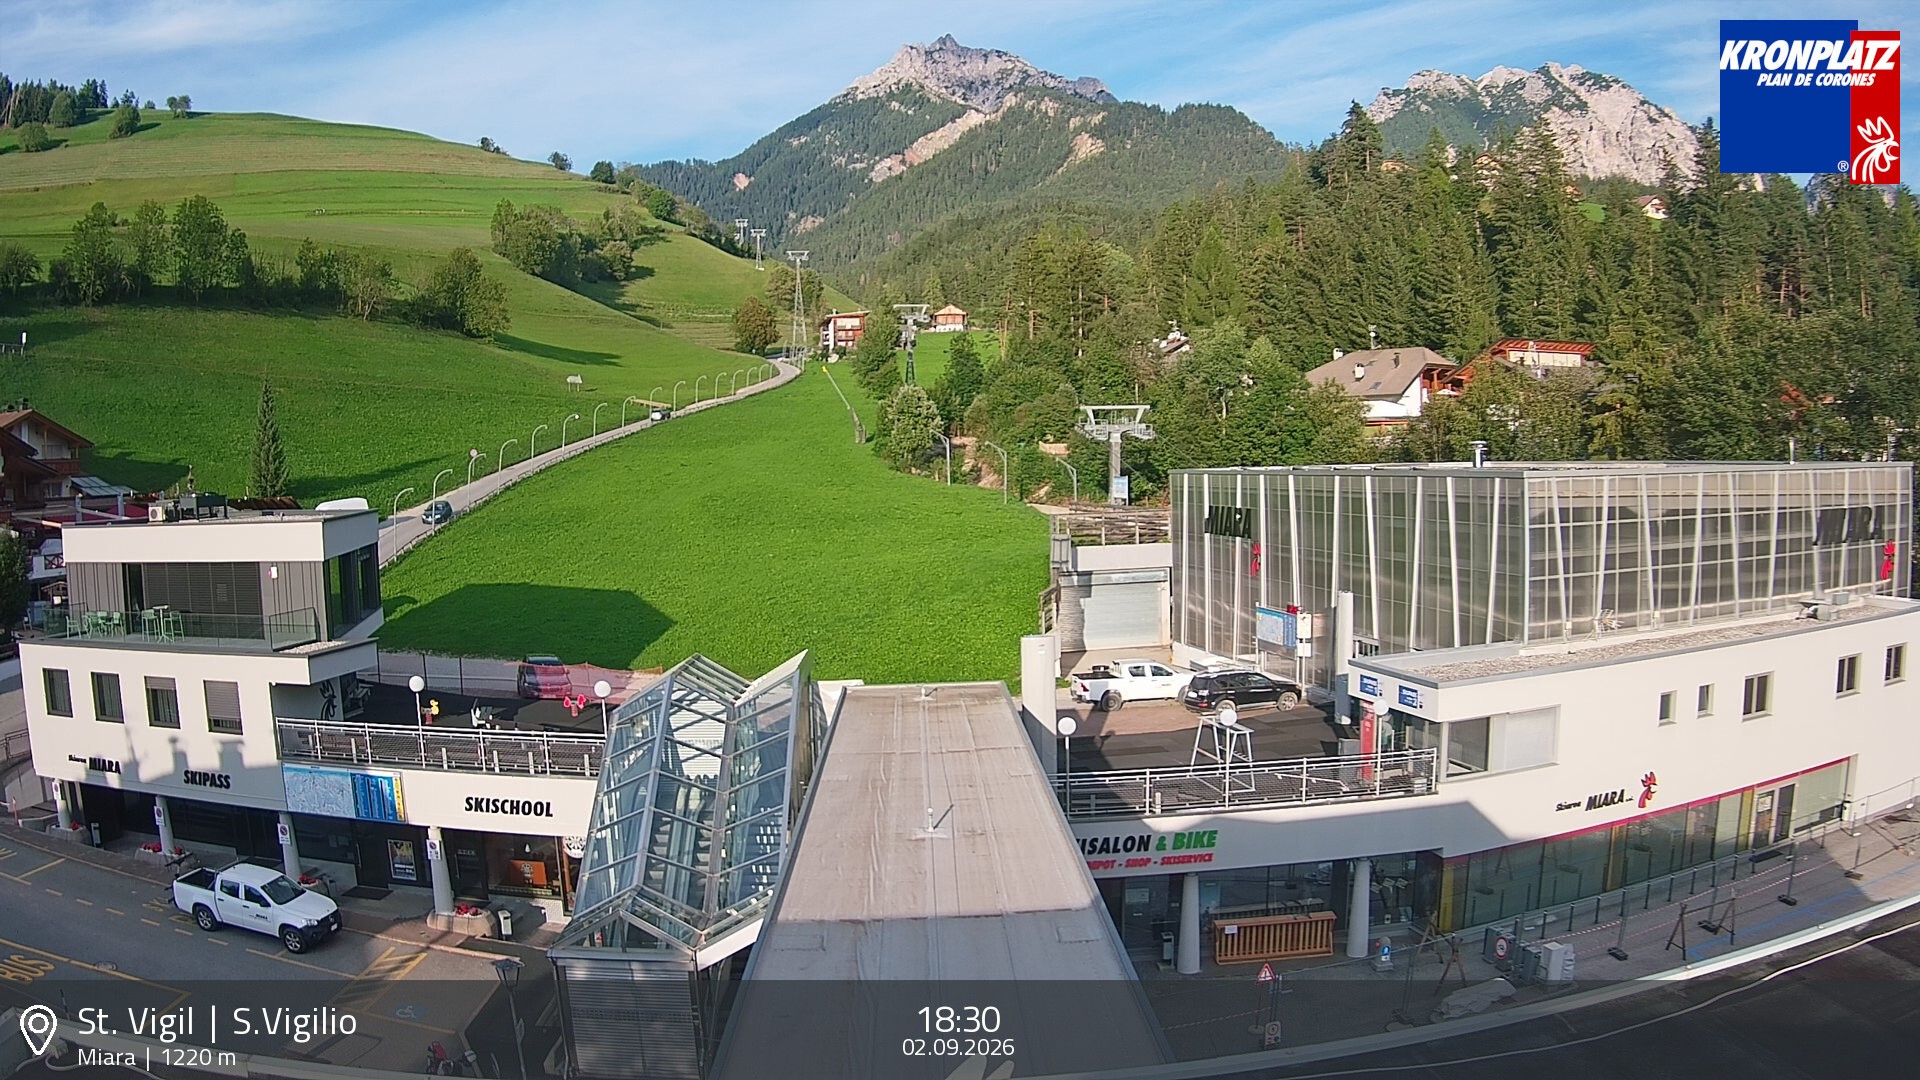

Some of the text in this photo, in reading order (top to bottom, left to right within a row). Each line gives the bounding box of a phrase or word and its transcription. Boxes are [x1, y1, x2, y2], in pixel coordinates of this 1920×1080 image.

[1204, 505, 1252, 539] MIARA
[89, 756, 122, 775] MIARA
[183, 769, 231, 790] SKIPASS
[464, 796, 554, 818] SKISCHOOL
[1585, 788, 1625, 812] MIARA
[1075, 829, 1219, 856] ISALON & BIKE
[1124, 857, 1152, 869] SHOP
[1160, 852, 1214, 867] SKISERVICE
